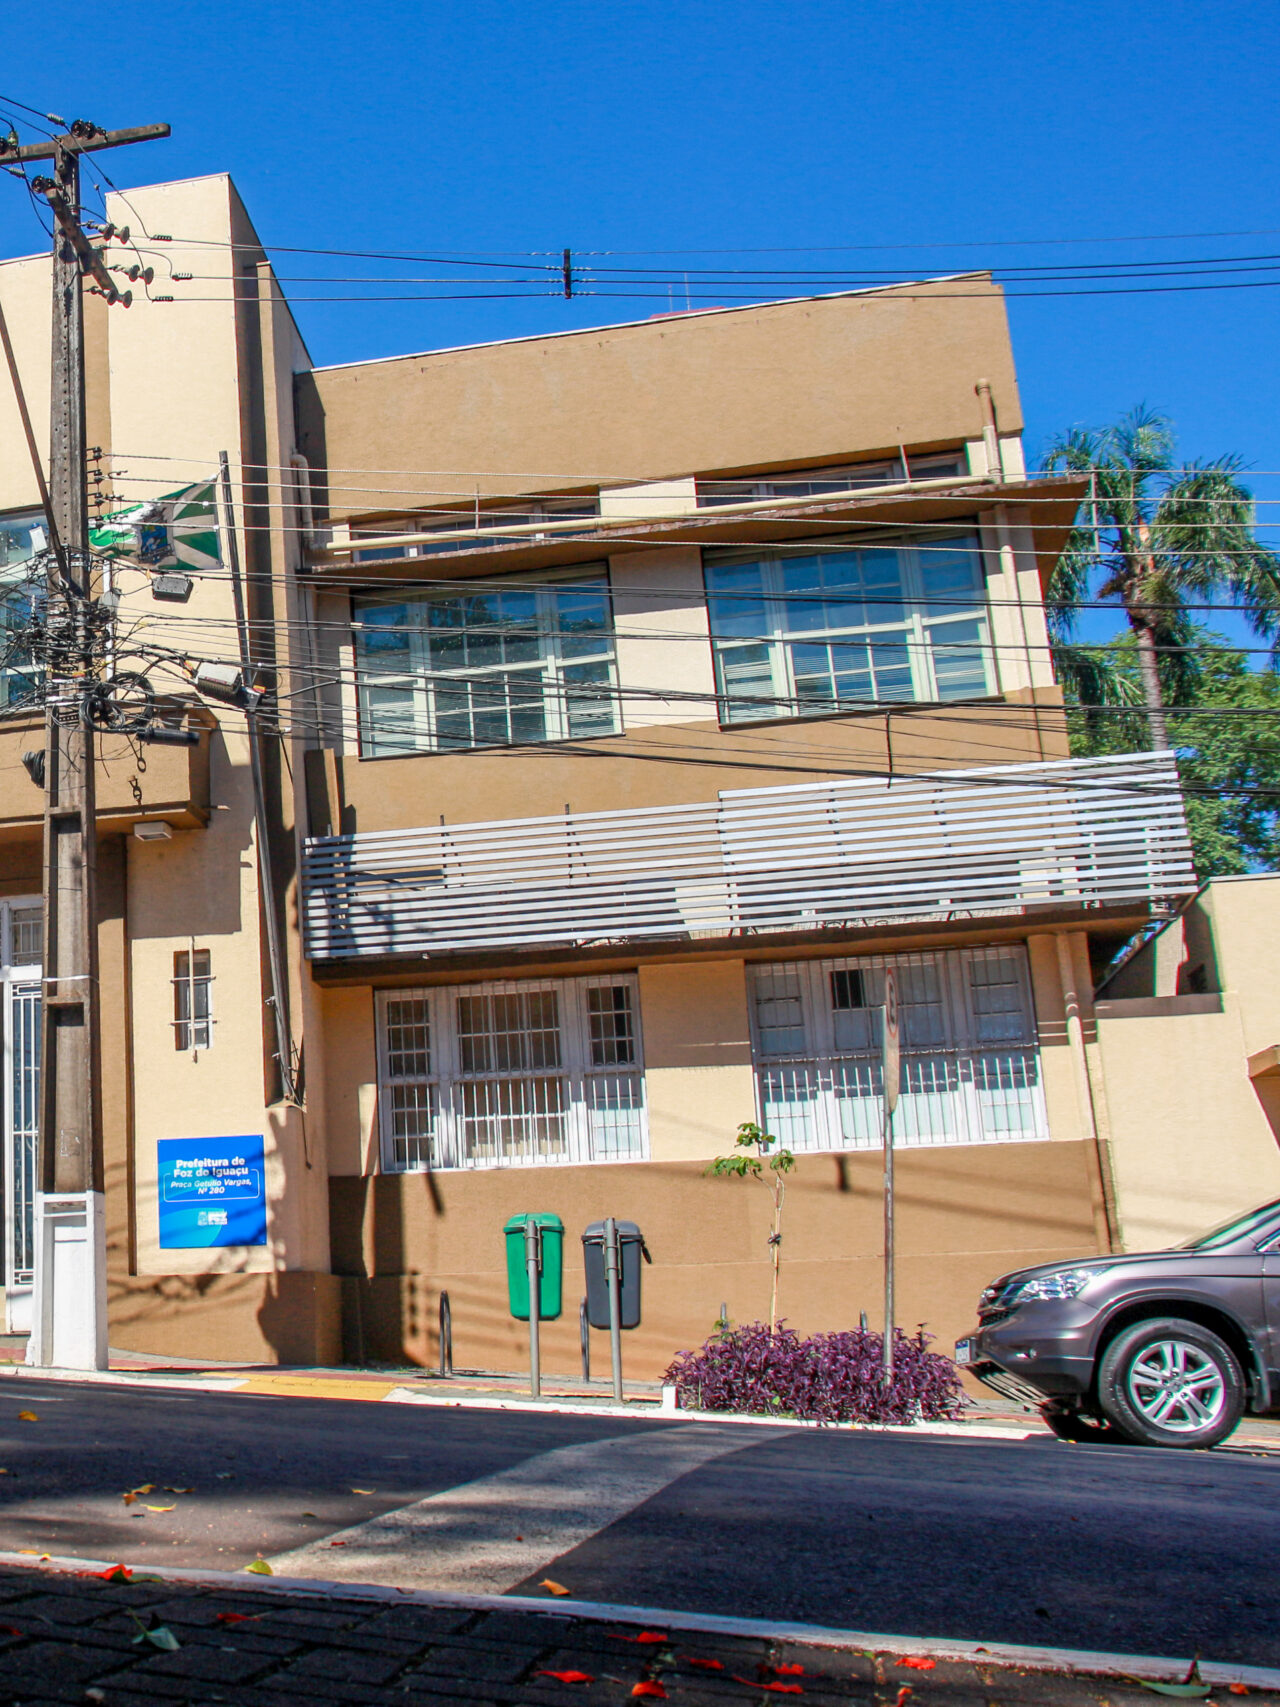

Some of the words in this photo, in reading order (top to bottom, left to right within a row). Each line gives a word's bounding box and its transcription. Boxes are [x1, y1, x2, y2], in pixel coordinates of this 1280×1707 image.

[176, 1158, 229, 1169] Prefeitura
[231, 1156, 246, 1166] de
[173, 1169, 193, 1178] Foz
[196, 1168, 210, 1177] do
[212, 1167, 249, 1177] Iguaçu
[170, 1181, 192, 1189] Praça
[224, 1178, 252, 1187] Vargas,
[208, 1186, 226, 1195] 280
